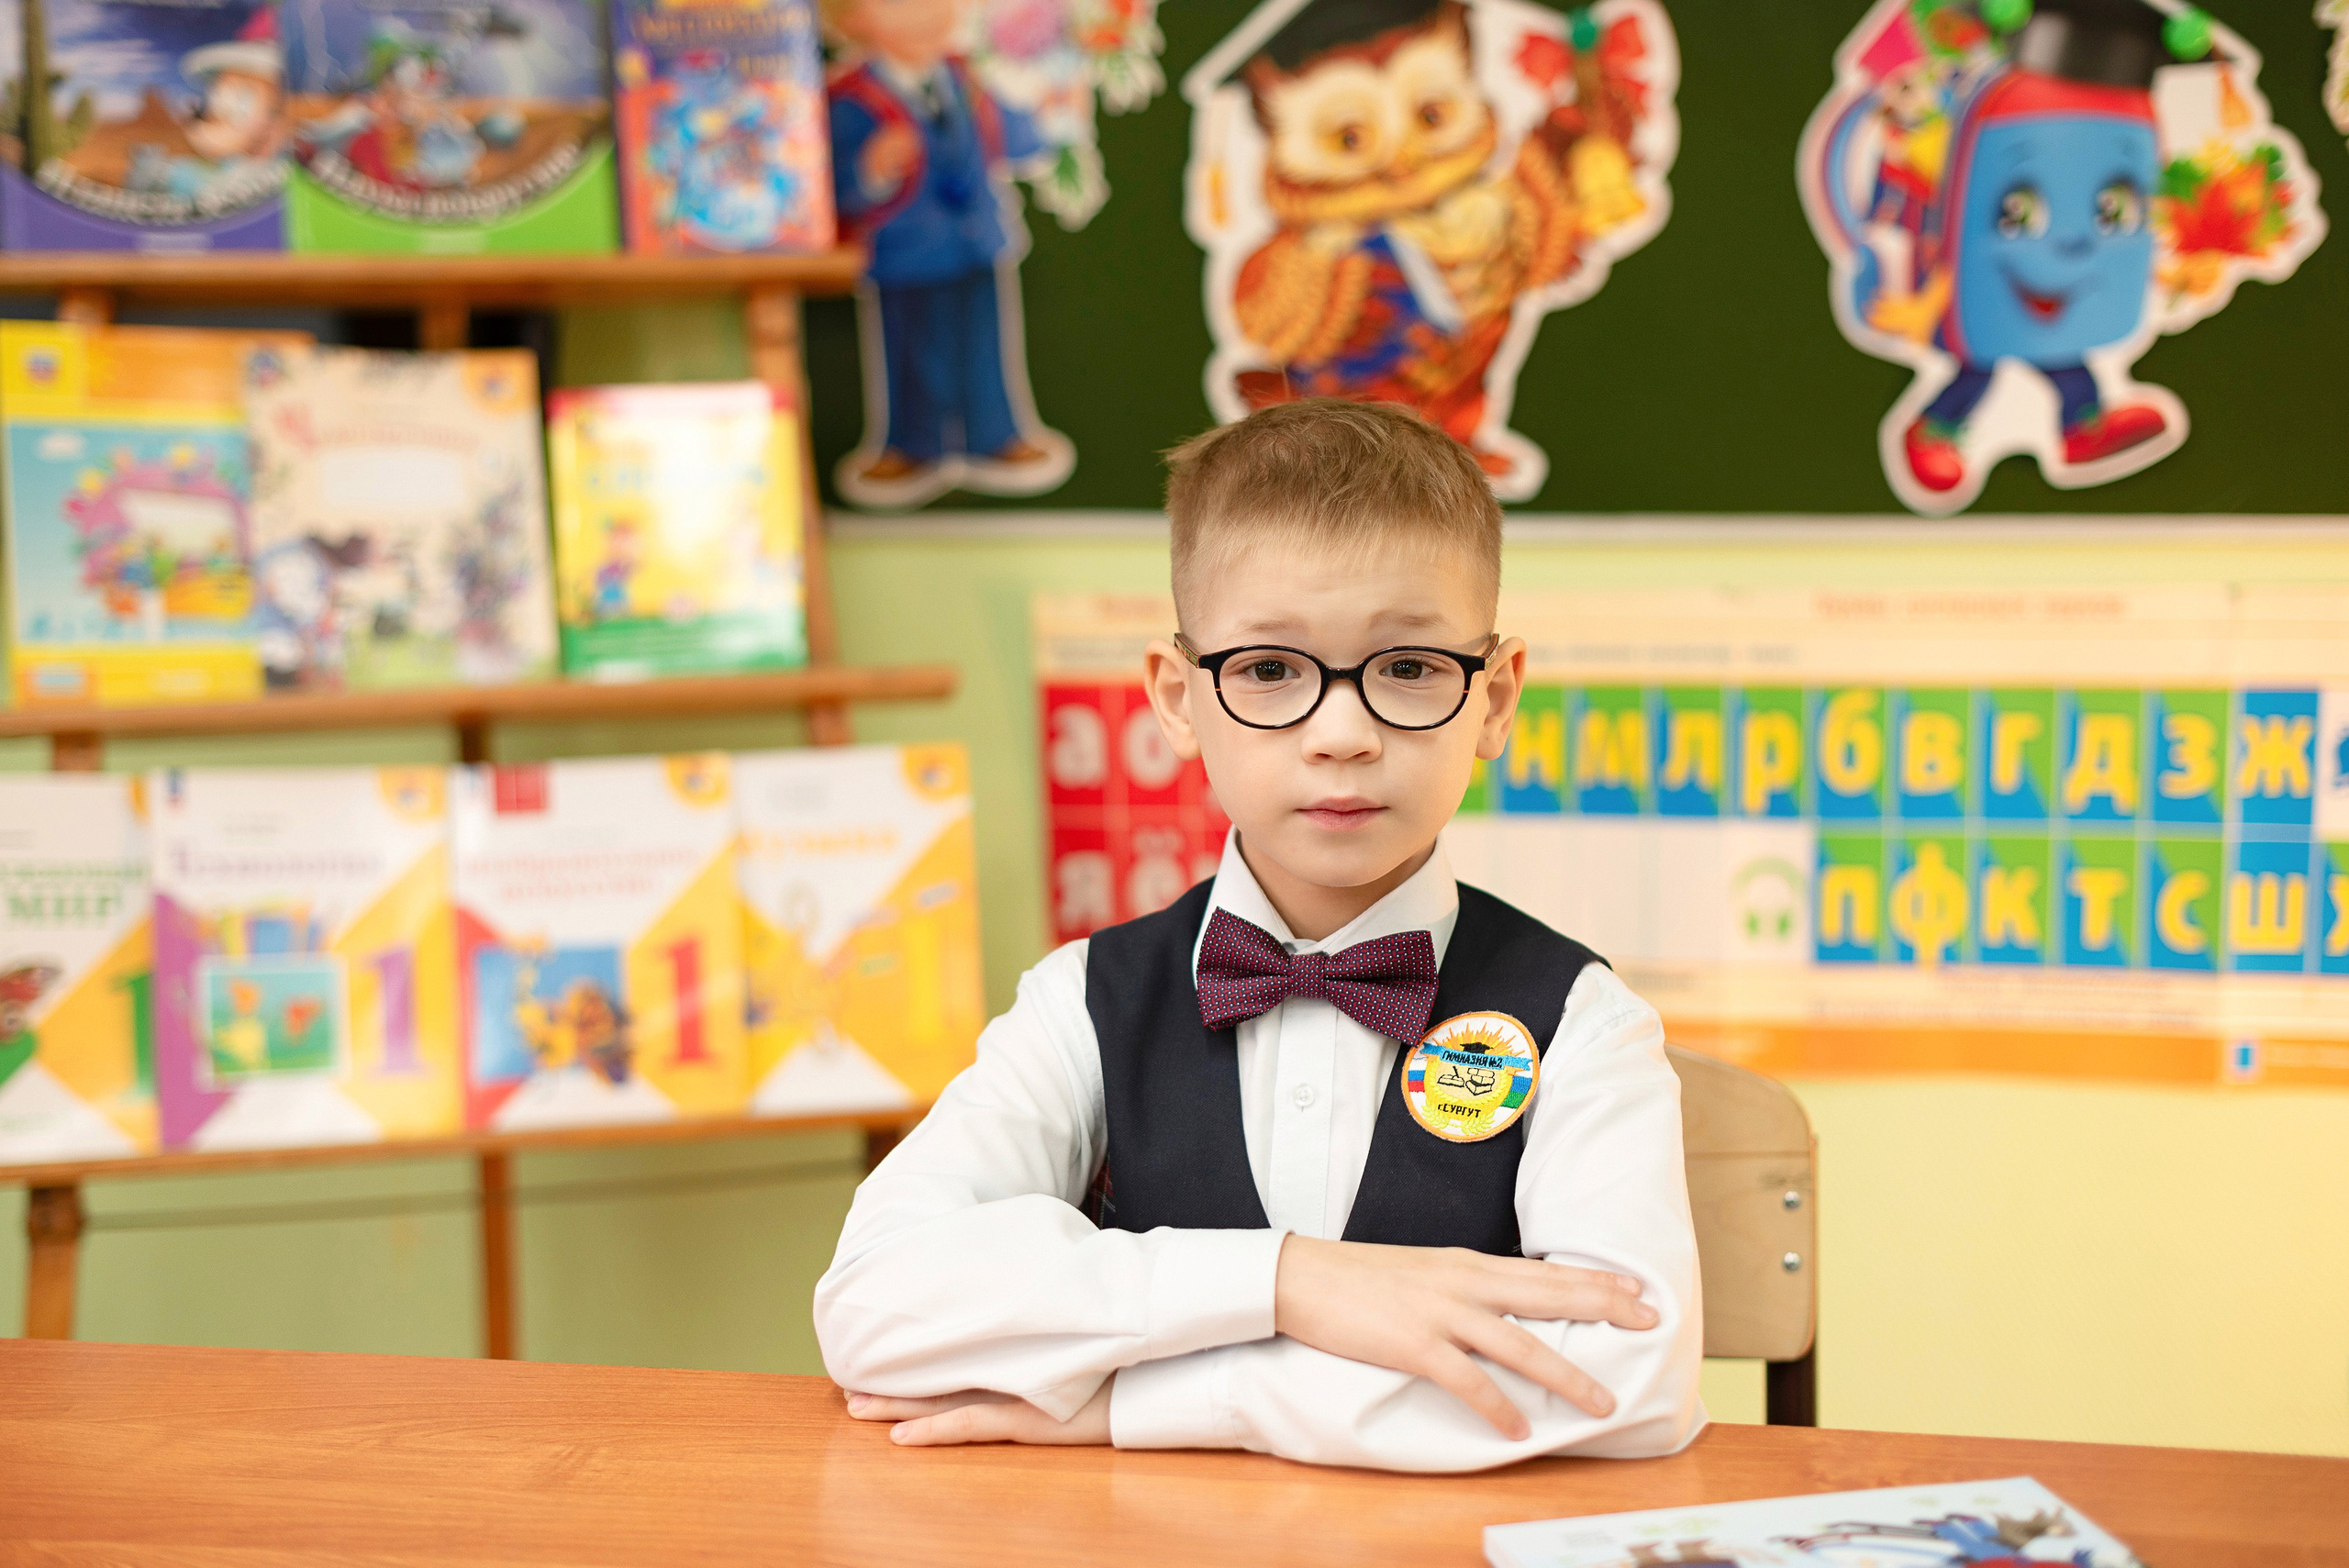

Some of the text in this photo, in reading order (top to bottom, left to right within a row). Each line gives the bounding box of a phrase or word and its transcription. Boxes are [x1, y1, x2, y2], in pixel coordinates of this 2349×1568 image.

[1575, 710, 1650, 790] м
[1665, 711, 1721, 790] л
[1743, 711, 1801, 811] р
[1819, 686, 1886, 795] б
[1901, 711, 1965, 798] в
[1989, 711, 2042, 795] г
[2064, 711, 2138, 815] д
[2160, 713, 2218, 799] з
[2238, 714, 2313, 798] ж
[1820, 862, 1879, 945] п
[1889, 840, 1970, 971] ф
[1981, 865, 2041, 950] к
[2071, 867, 2128, 951] т
[2155, 871, 2210, 955] с
[2229, 872, 2307, 954] ш
[367, 945, 435, 1075] 1
[659, 938, 719, 1064] 1
